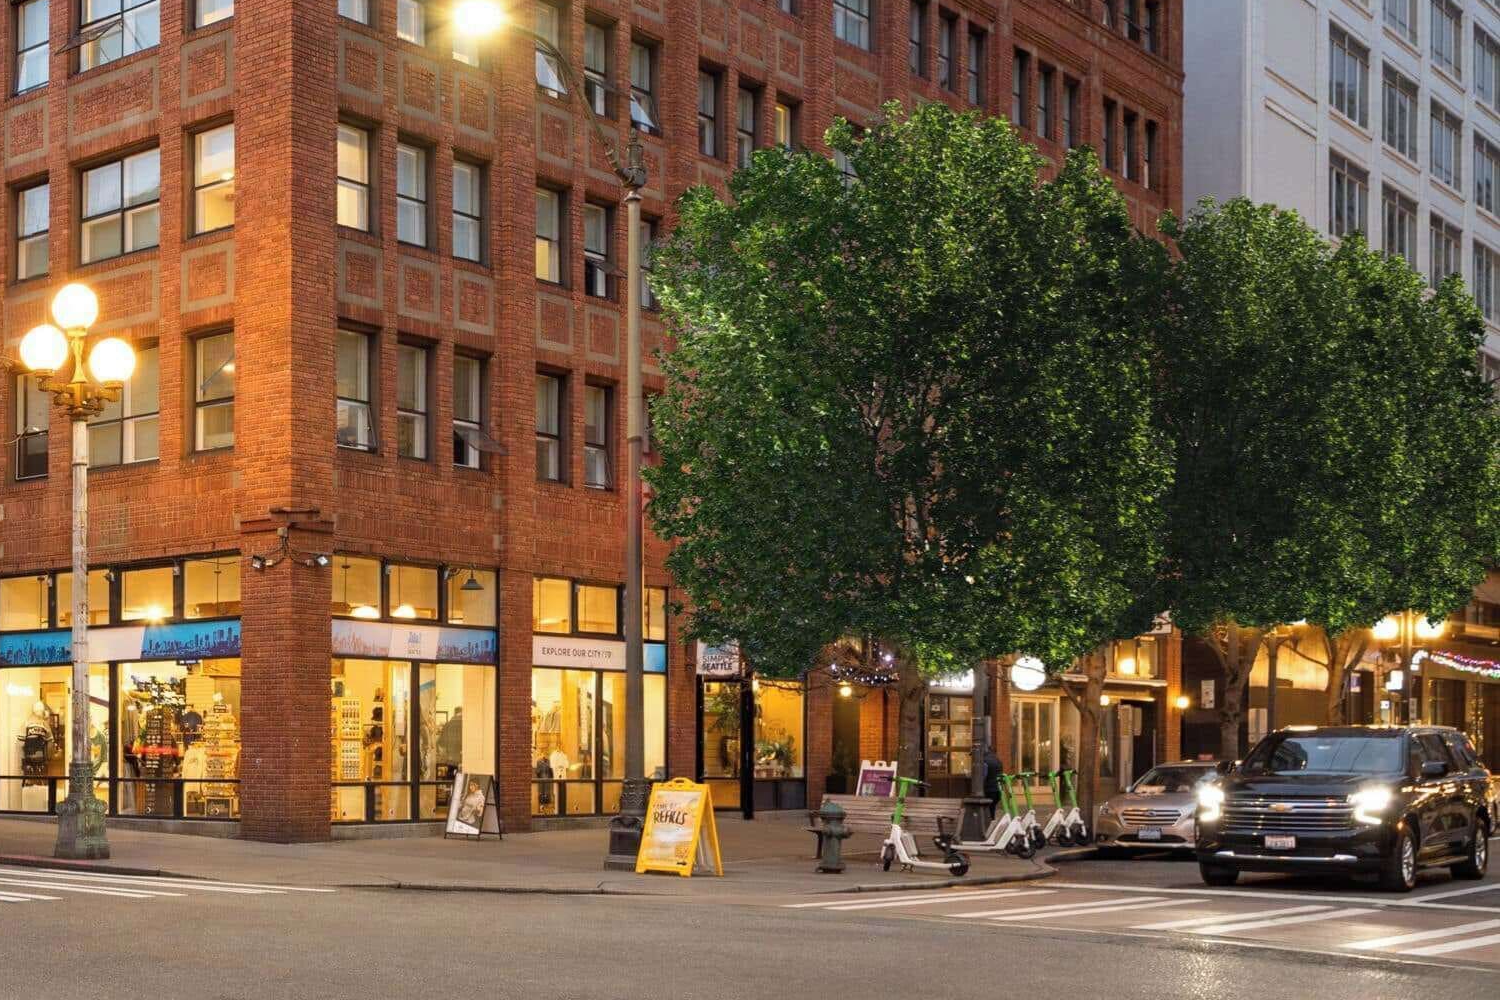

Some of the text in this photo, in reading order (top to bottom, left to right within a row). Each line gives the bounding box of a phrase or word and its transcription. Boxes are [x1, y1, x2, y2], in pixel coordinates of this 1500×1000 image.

[542, 647, 571, 657] EXPLORE
[572, 648, 586, 657] OUR
[702, 662, 733, 671] SEATTLE
